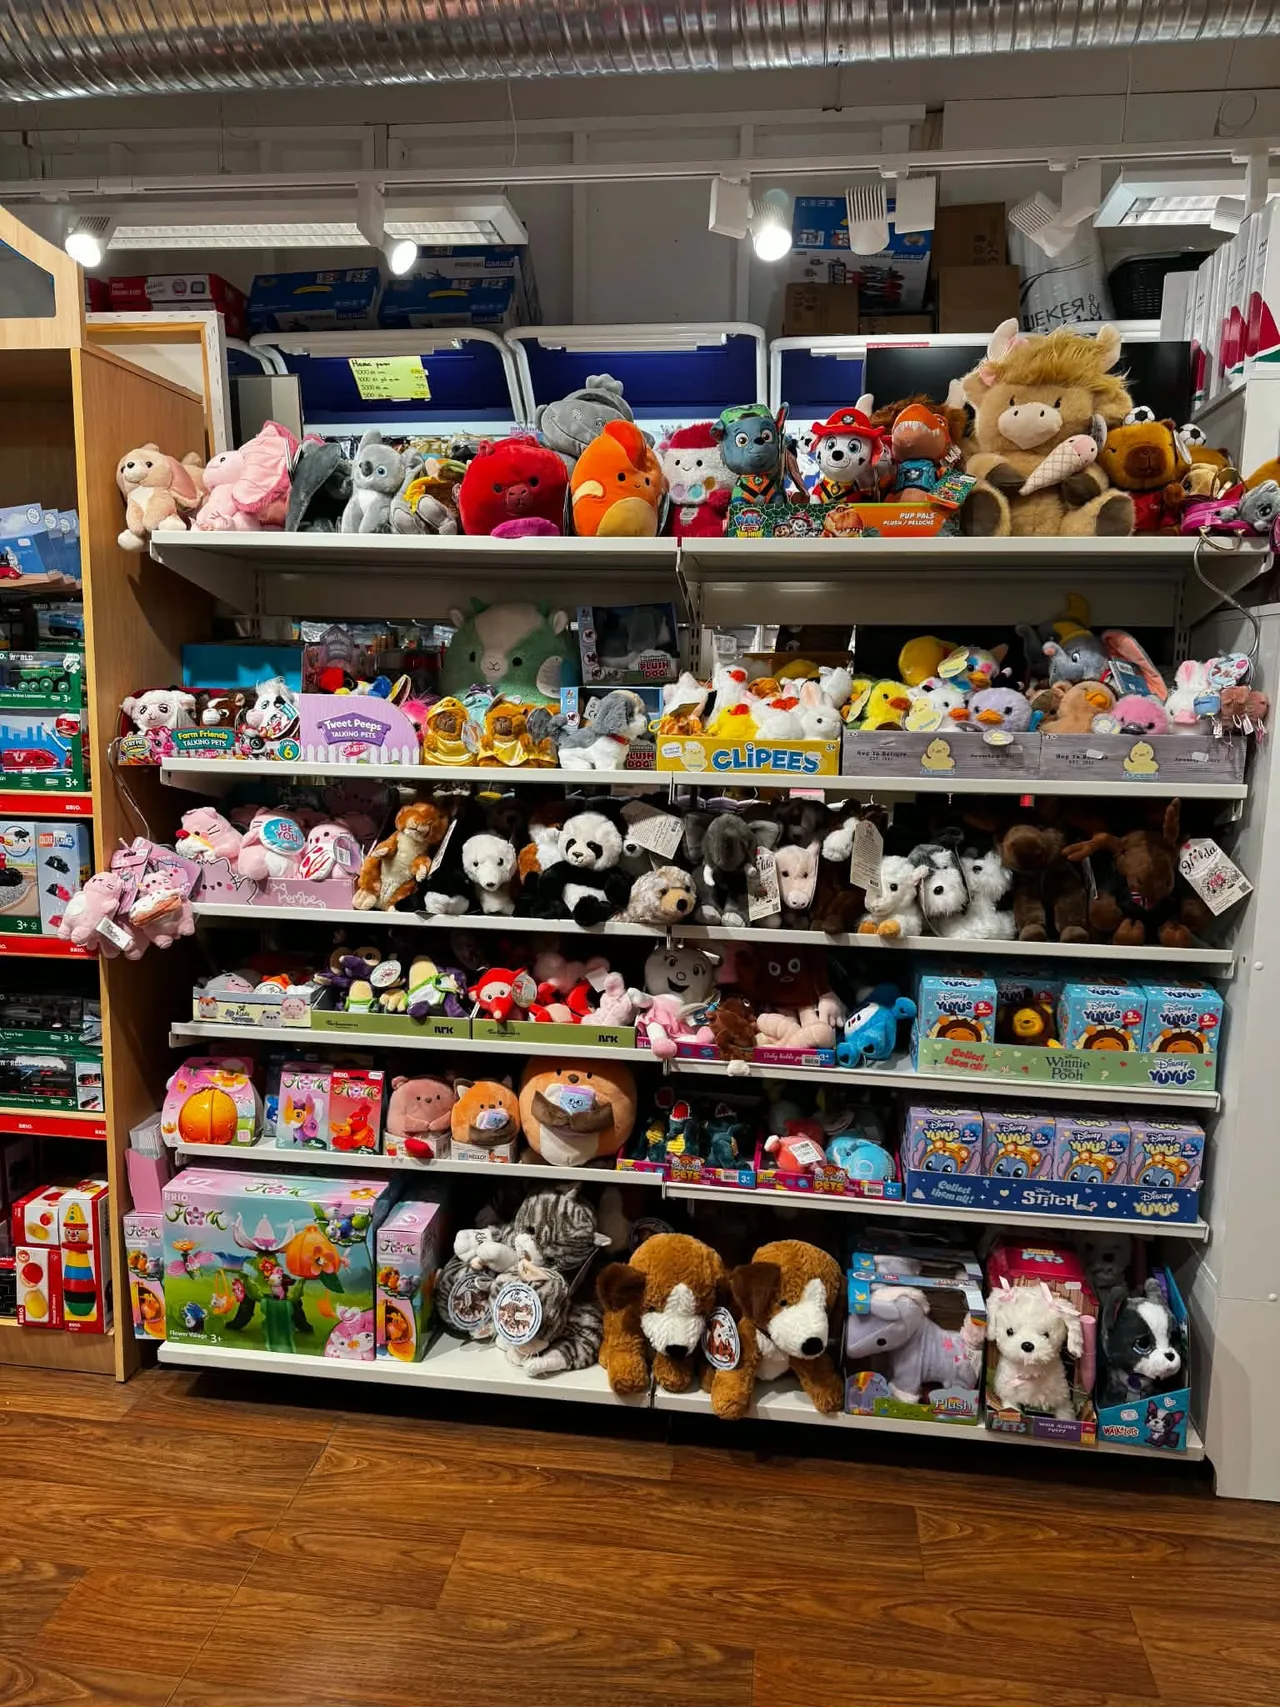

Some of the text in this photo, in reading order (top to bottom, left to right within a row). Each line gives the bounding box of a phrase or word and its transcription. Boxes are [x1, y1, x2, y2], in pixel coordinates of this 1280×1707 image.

[639, 661, 671, 671] PLUSH
[63, 694, 71, 702] 3+
[324, 718, 382, 732] Tweet Peeps
[199, 730, 229, 739] Friends
[360, 731, 376, 739] PETS
[182, 739, 210, 747] TALKING
[284, 746, 292, 758] 6
[627, 760, 652, 768] DOG
[65, 777, 78, 788] 3+
[280, 823, 292, 832] BE
[275, 830, 298, 842] YOU
[17, 920, 28, 930] 3+
[941, 992, 968, 1001] Disney
[1091, 1001, 1115, 1010] Disney
[1168, 1005, 1192, 1013] Disney
[951, 1048, 985, 1061] Collect
[944, 1057, 969, 1068] them
[1046, 1057, 1091, 1069] Winnie
[1154, 1058, 1189, 1069] Disney
[1051, 1068, 1083, 1080] Pooh
[929, 1119, 955, 1129] Disney
[1000, 1123, 1026, 1132] Disney
[1077, 1132, 1102, 1140] Disney
[1149, 1134, 1175, 1142] Disney
[672, 1170, 701, 1180] PETS
[741, 1175, 750, 1183] 3+
[815, 1181, 845, 1192] PETS
[938, 1180, 972, 1194] Collect
[164, 1192, 189, 1202] BRIO
[931, 1188, 956, 1200] them
[1139, 1191, 1173, 1201] Disney
[1022, 1252, 1064, 1264] PETS
[169, 1329, 208, 1340] Flower Village
[210, 1334, 222, 1343] 3+
[935, 1399, 968, 1411] Plush
[992, 1421, 1027, 1434] PETS
